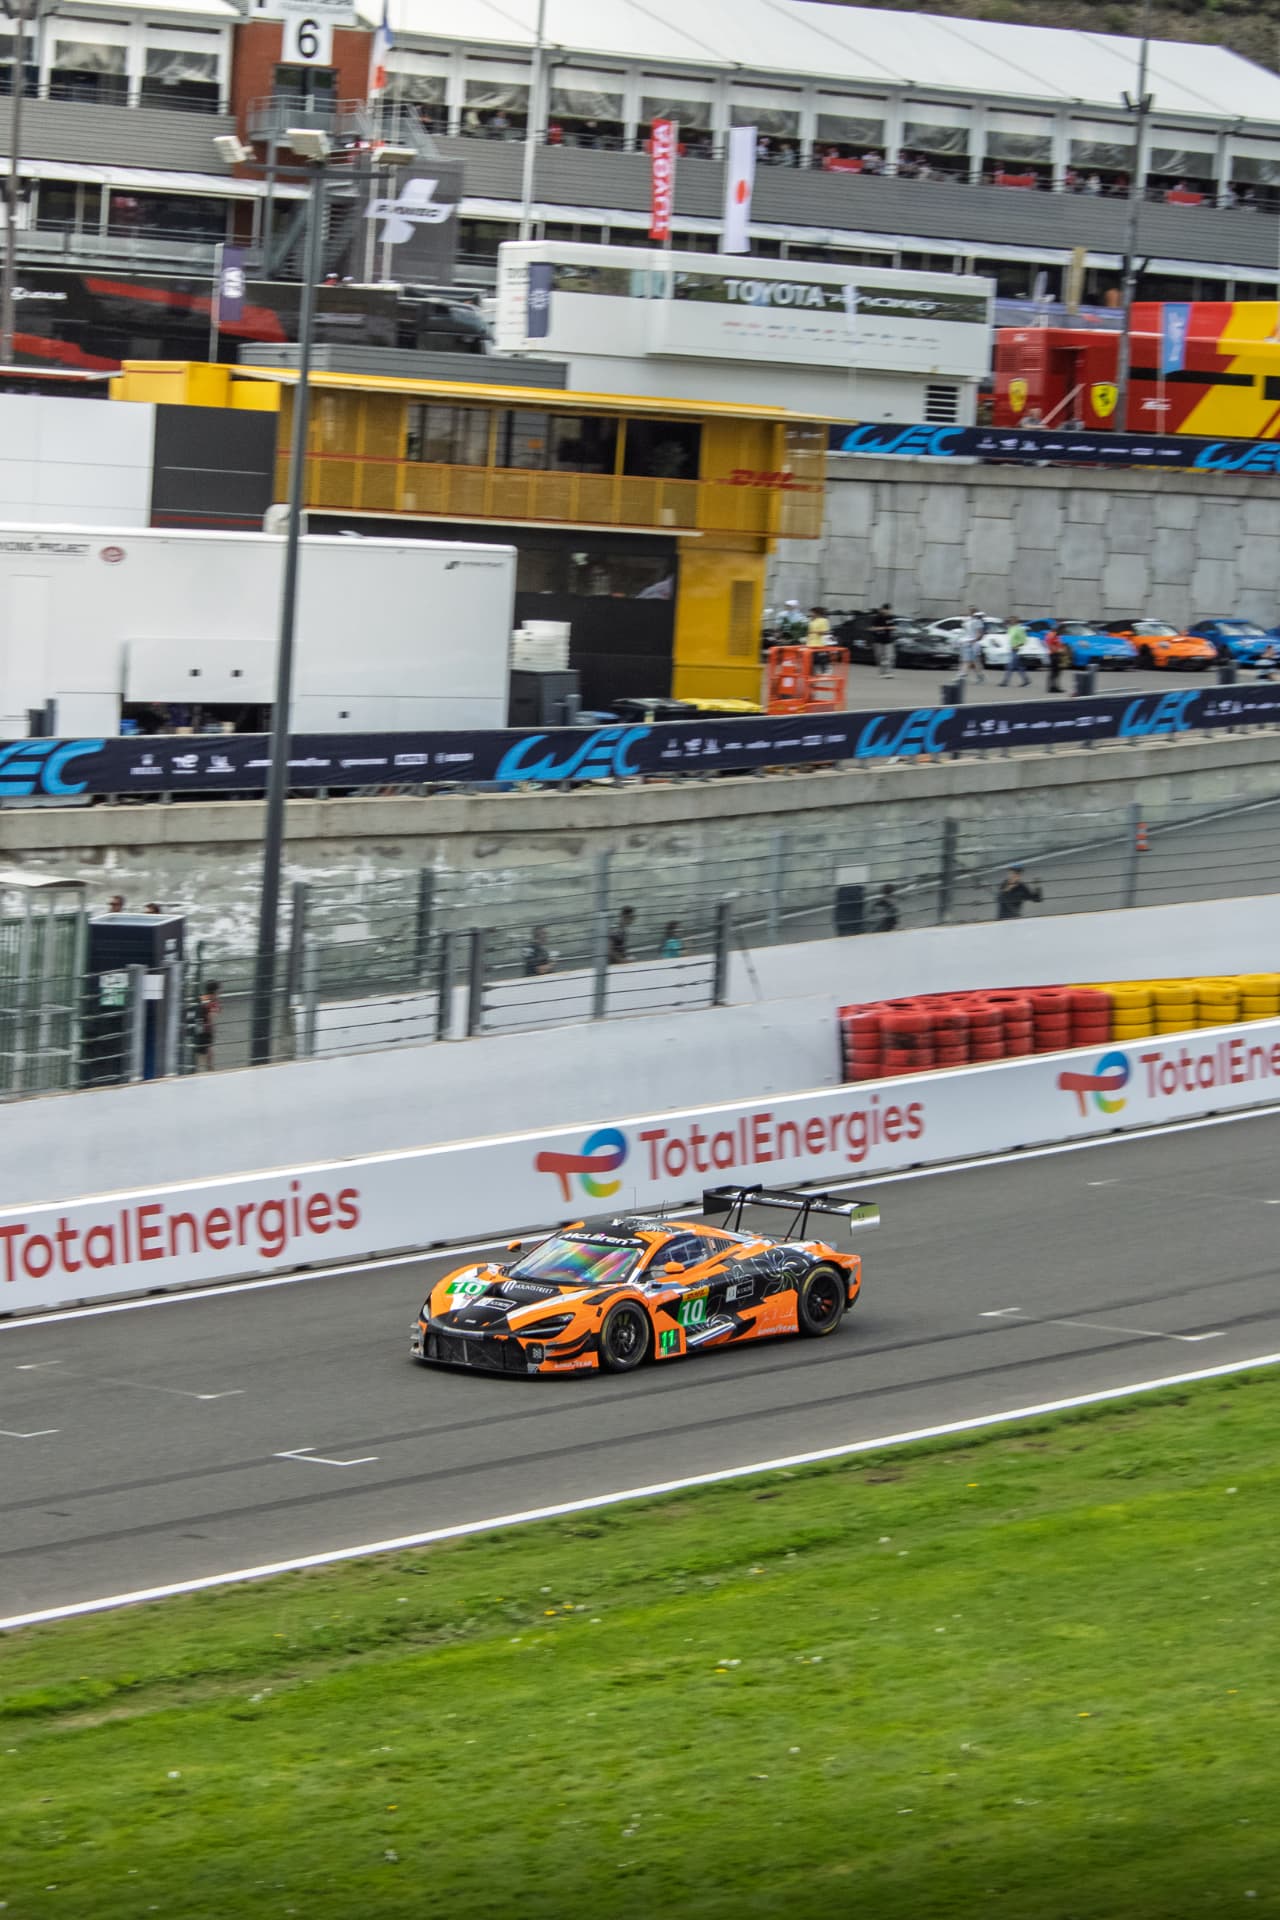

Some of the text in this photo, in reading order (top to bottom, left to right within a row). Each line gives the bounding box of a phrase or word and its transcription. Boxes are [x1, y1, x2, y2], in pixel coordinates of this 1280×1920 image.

[297, 19, 320, 58] 6
[723, 279, 827, 307] TOYOTA
[842, 426, 967, 457] WEC
[1194, 442, 1280, 472] WE
[854, 708, 957, 759] WEC
[1118, 690, 1202, 738] WEC
[494, 726, 653, 781] WEC
[638, 1094, 925, 1181] TotalEnergies
[0, 1179, 361, 1283] TotalEnergies
[453, 1281, 481, 1296] 10
[681, 1297, 704, 1326] 10
